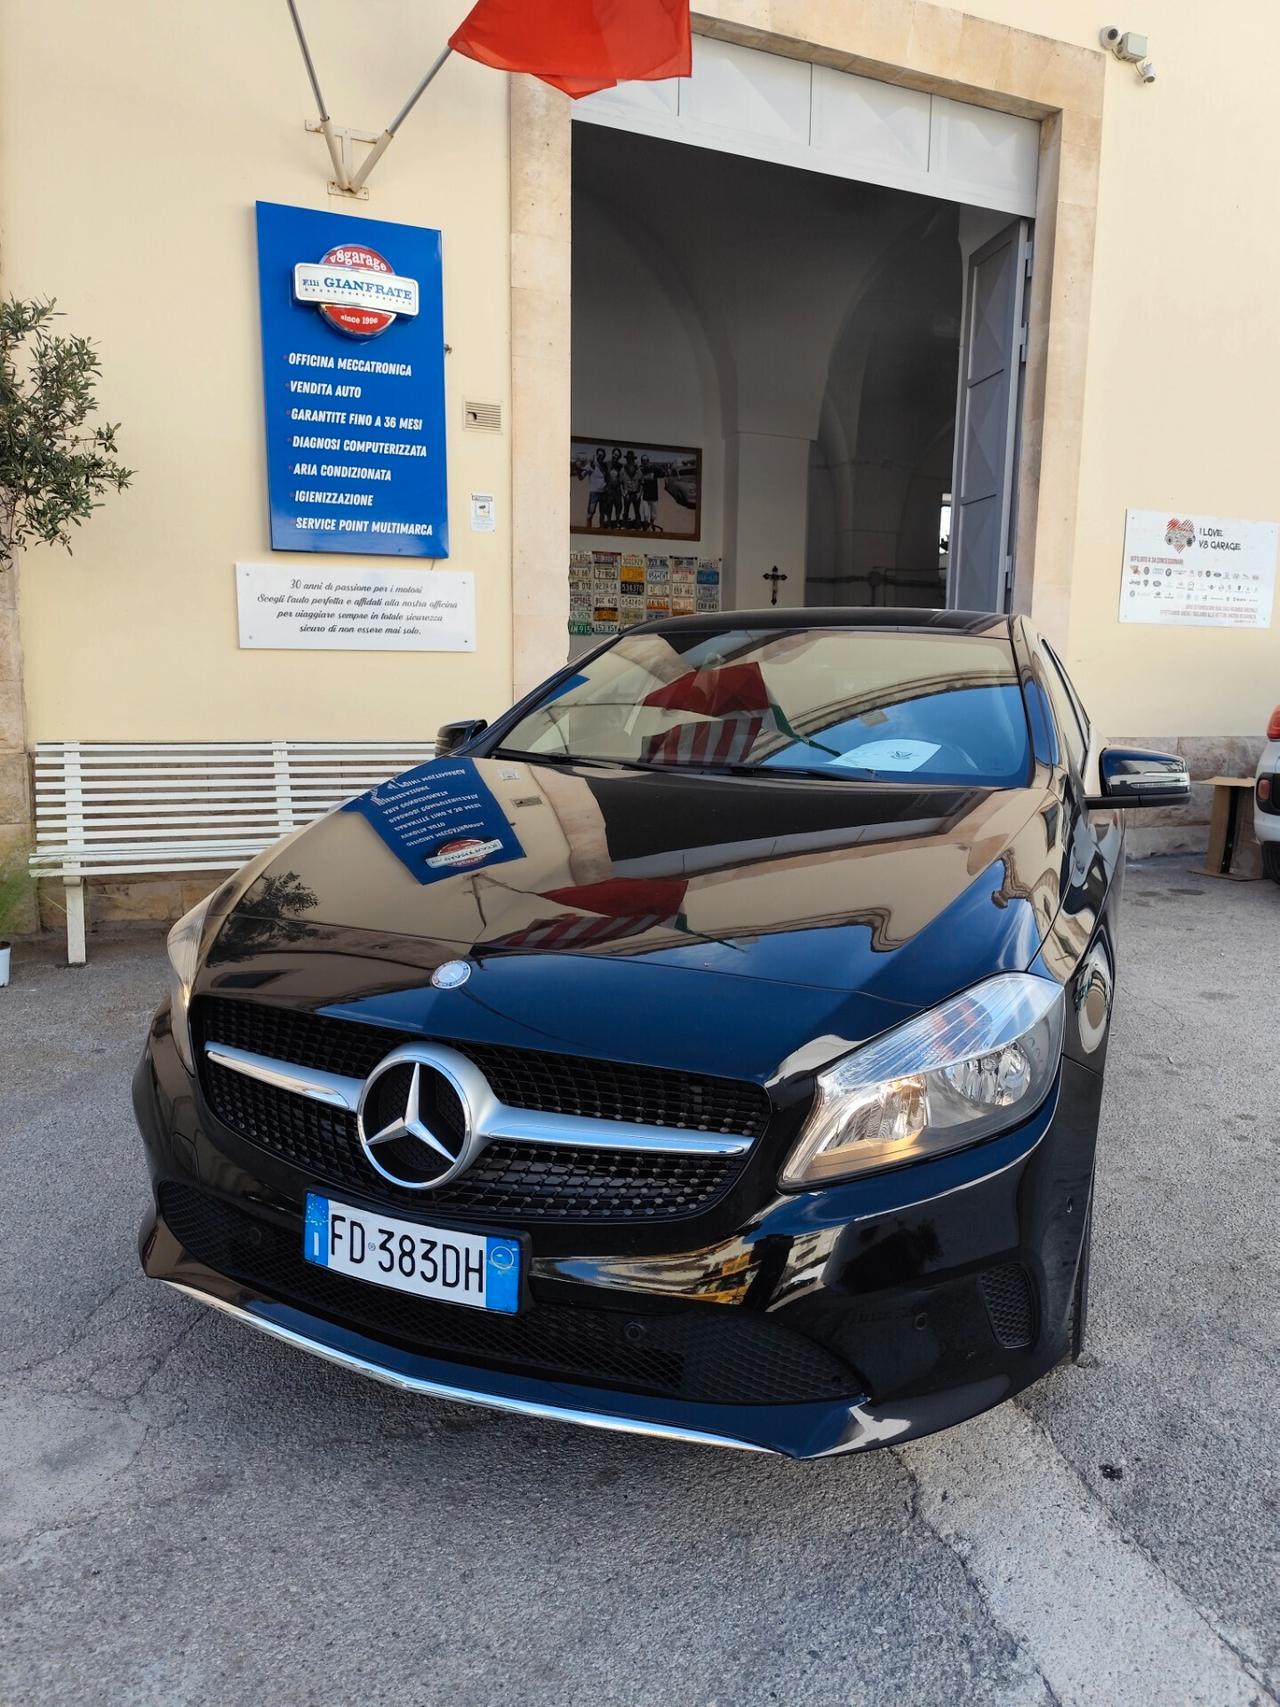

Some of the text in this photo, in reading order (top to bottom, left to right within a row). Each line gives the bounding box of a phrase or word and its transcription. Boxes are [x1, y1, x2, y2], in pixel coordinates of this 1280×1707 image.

[329, 249, 387, 271] v8garage
[323, 277, 412, 301] GIANFRATE
[340, 314, 360, 324] since
[288, 352, 412, 377] OFFICINA MECCATRONICA
[290, 380, 362, 399] VENDITA AUTO
[291, 408, 423, 431] GARANTITE FINO A 36 MESI
[292, 435, 427, 457] DIAGNOSI COMPUTERIZZATA
[293, 463, 392, 481] ARIA CONDIZIONATA
[295, 490, 374, 507] IGIENIZZAZIONE
[296, 517, 433, 536] SERVICE POINT MULTIMARCA
[1202, 527, 1224, 537] LOVE
[1210, 541, 1242, 551] GARAGE
[290, 578, 423, 594] 30 anni di passione per i motori
[257, 593, 286, 604] Scegli
[286, 595, 310, 604] l'auto
[310, 596, 344, 606] perfetta
[353, 597, 383, 608] affidati
[384, 598, 400, 607] alla
[401, 599, 427, 608] nostra
[428, 600, 458, 609] officina
[276, 610, 443, 622] per viaggiare sempre in totale sicurezza
[299, 624, 326, 633] sicuro
[328, 624, 338, 633] di
[356, 626, 383, 634] essere
[384, 626, 402, 634] mai
[402, 626, 422, 636] solo.
[331, 1213, 484, 1293] FD 383DH
